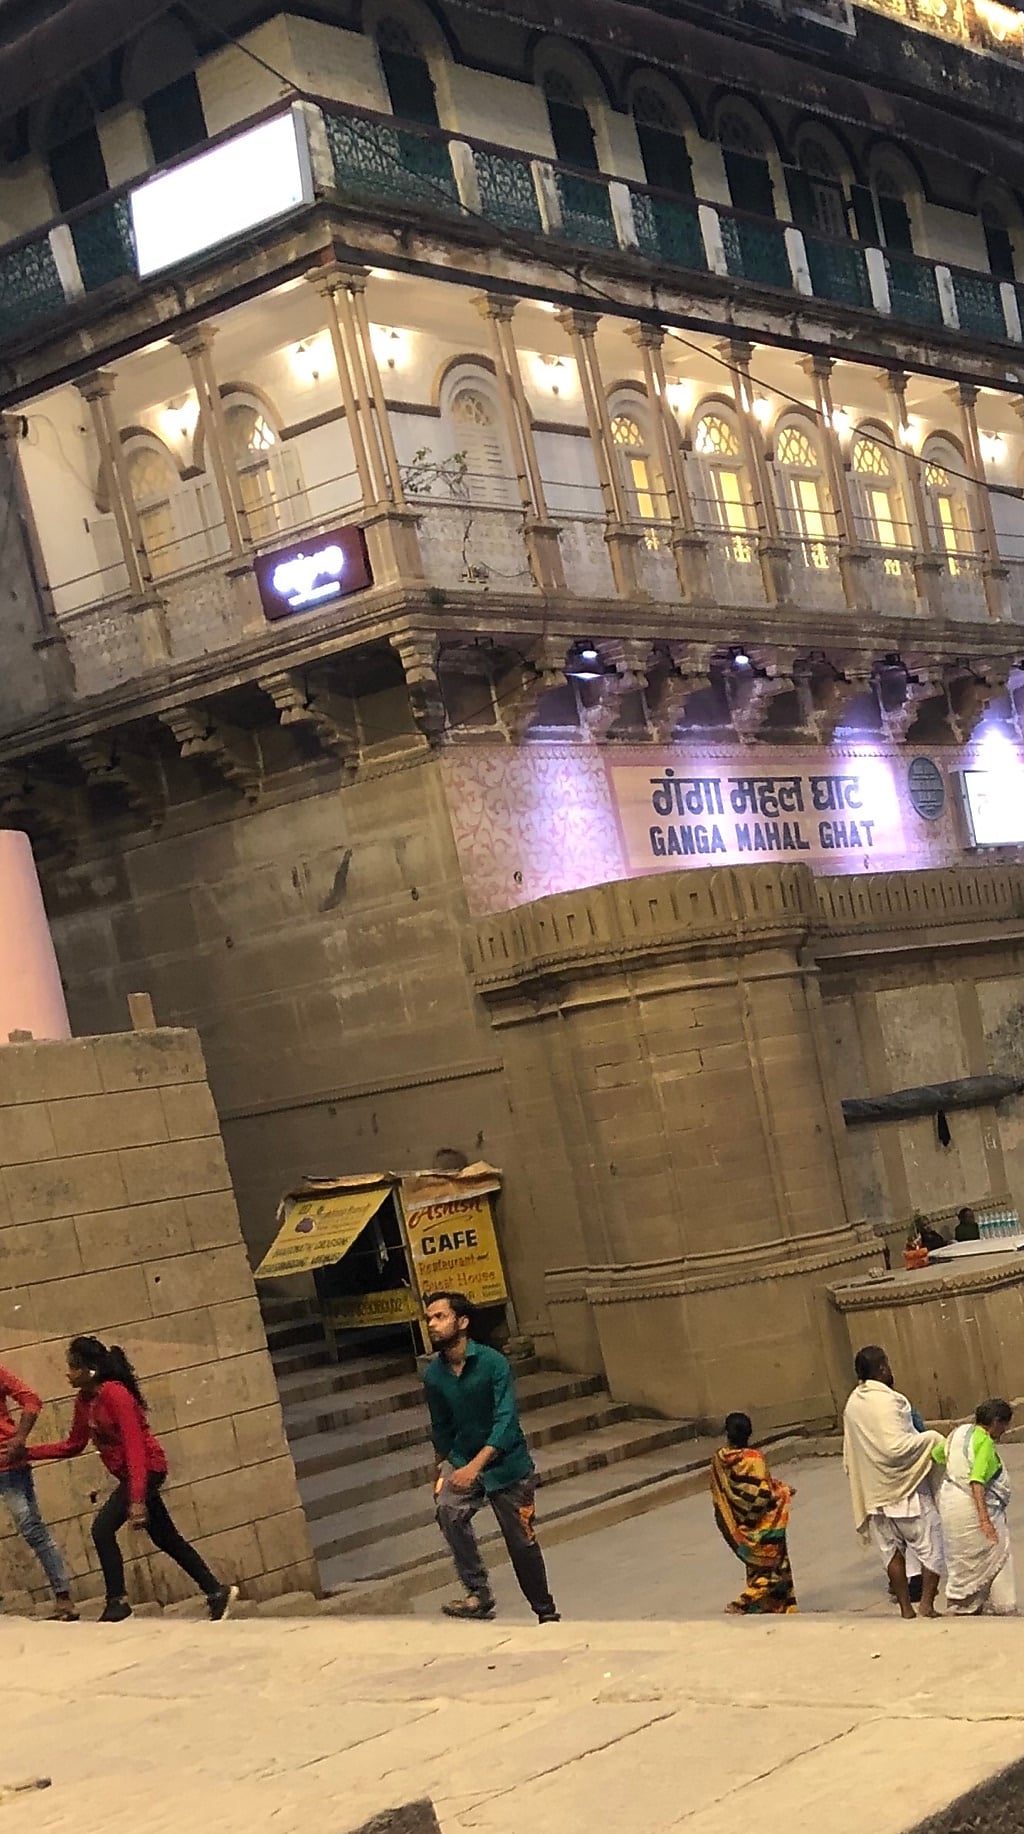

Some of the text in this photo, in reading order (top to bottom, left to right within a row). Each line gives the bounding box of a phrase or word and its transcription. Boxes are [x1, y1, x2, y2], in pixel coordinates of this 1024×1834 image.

[650, 768, 724, 816] गंगा
[727, 777, 804, 818] महल
[808, 775, 863, 811] घाट
[649, 820, 874, 856] GANGA MAHAL GHAT
[421, 1229, 478, 1255] CAFE
[458, 1271, 495, 1285] House
